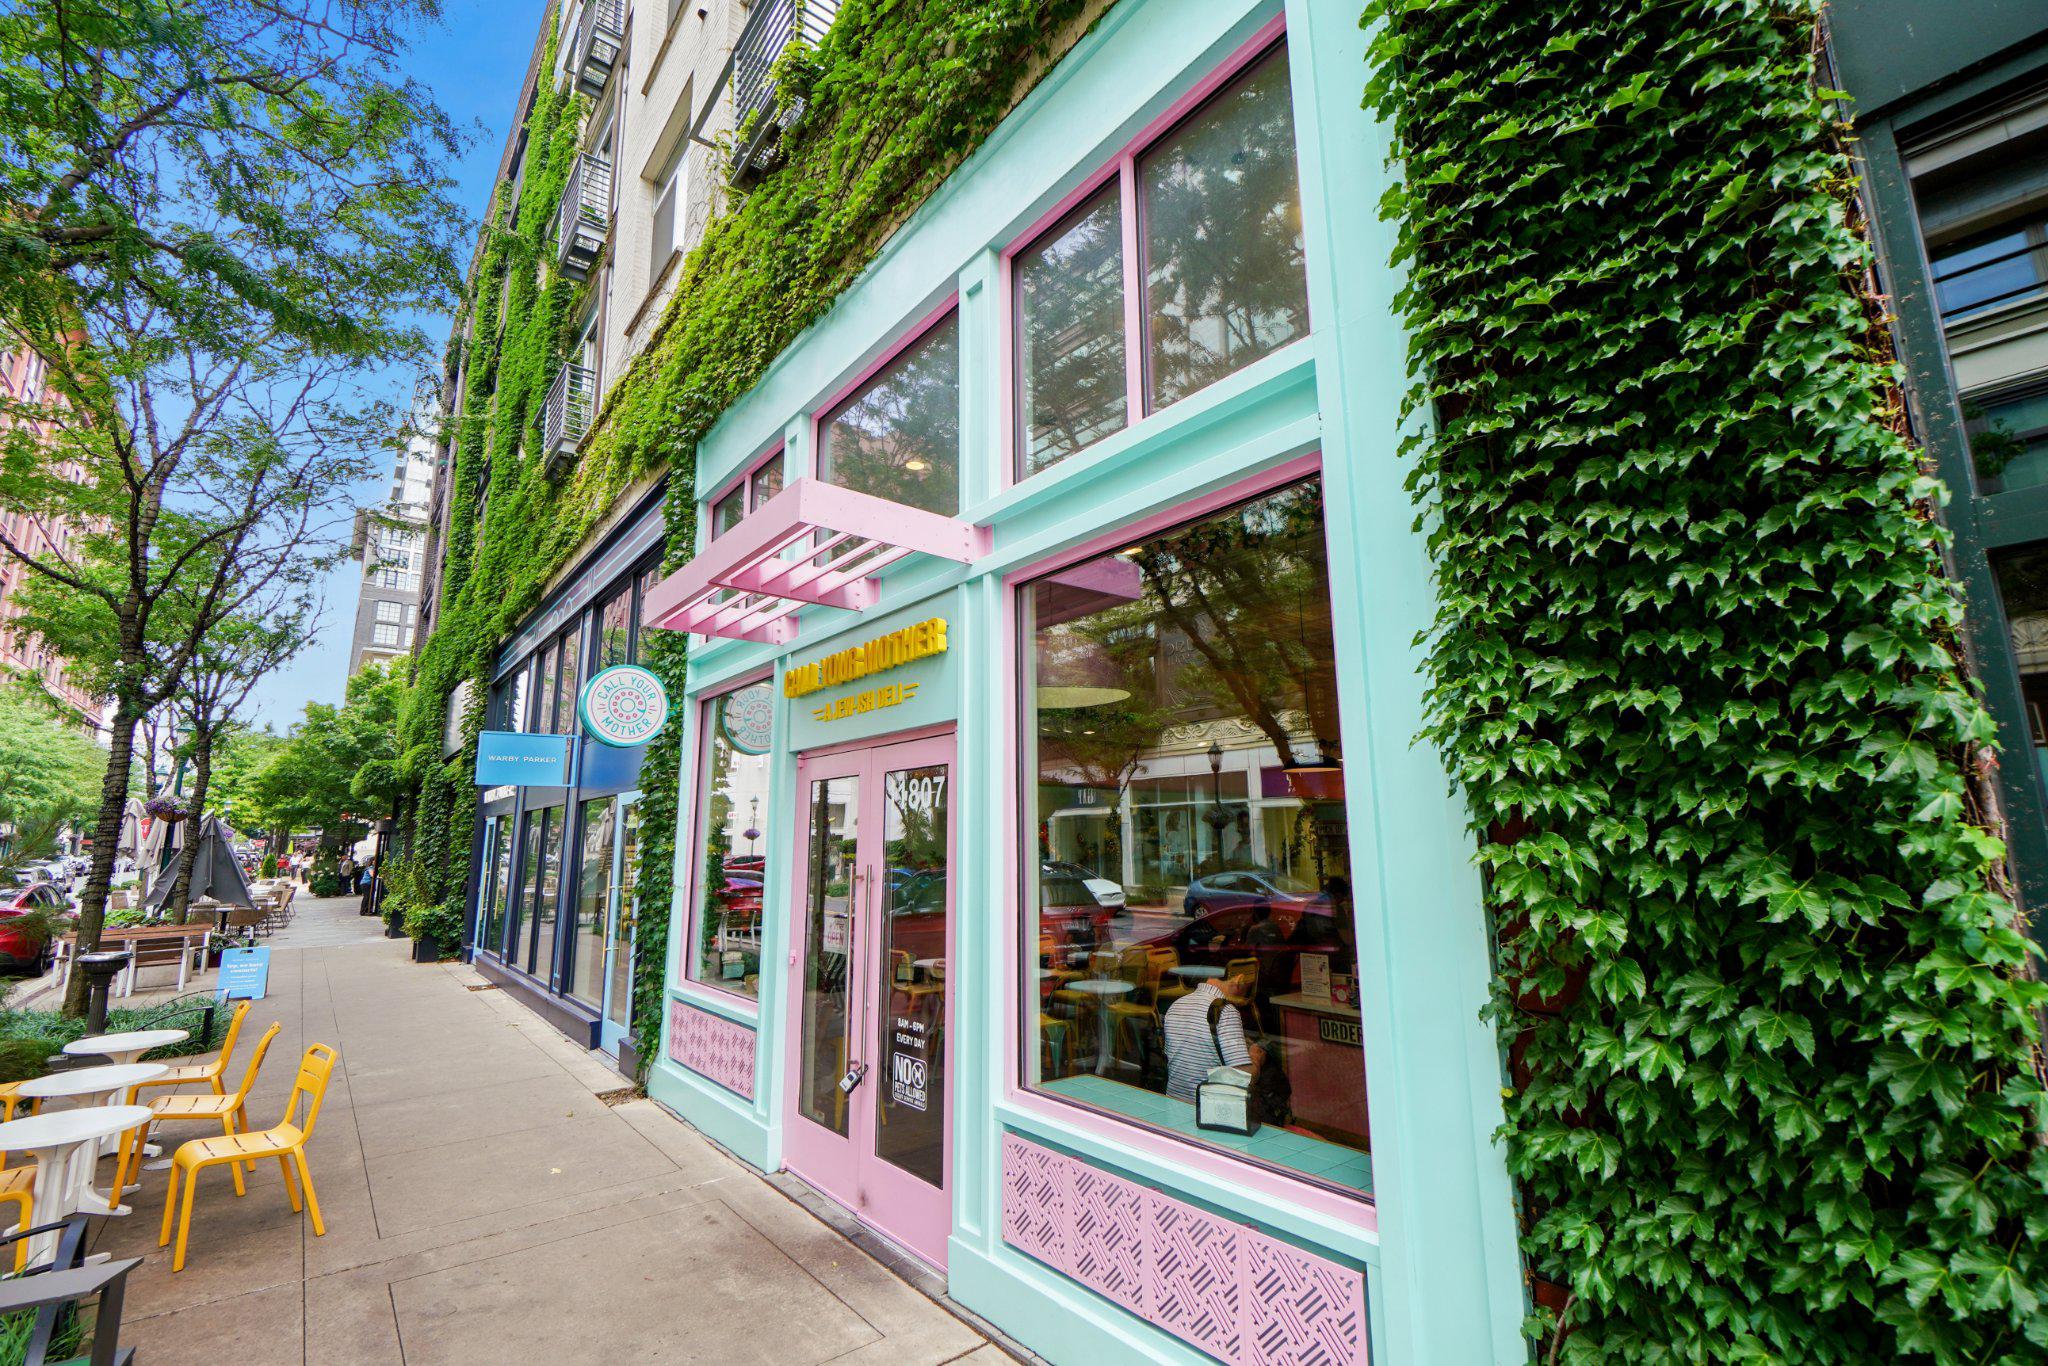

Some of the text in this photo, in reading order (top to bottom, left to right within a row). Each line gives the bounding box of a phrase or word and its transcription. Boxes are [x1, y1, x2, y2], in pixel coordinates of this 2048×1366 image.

[784, 617, 948, 698] CALL YOUR MOTHER
[598, 676, 657, 700] CALL YOUR
[823, 682, 902, 722] A JEW-ISH DELI
[602, 716, 652, 736] MOTHER
[897, 1017, 909, 1029] 8AM
[912, 1021, 925, 1033] 6PM
[896, 1032, 926, 1049] EVERY DAY
[895, 1055, 912, 1085] NO
[894, 1081, 926, 1102] PETS ALLOWED
